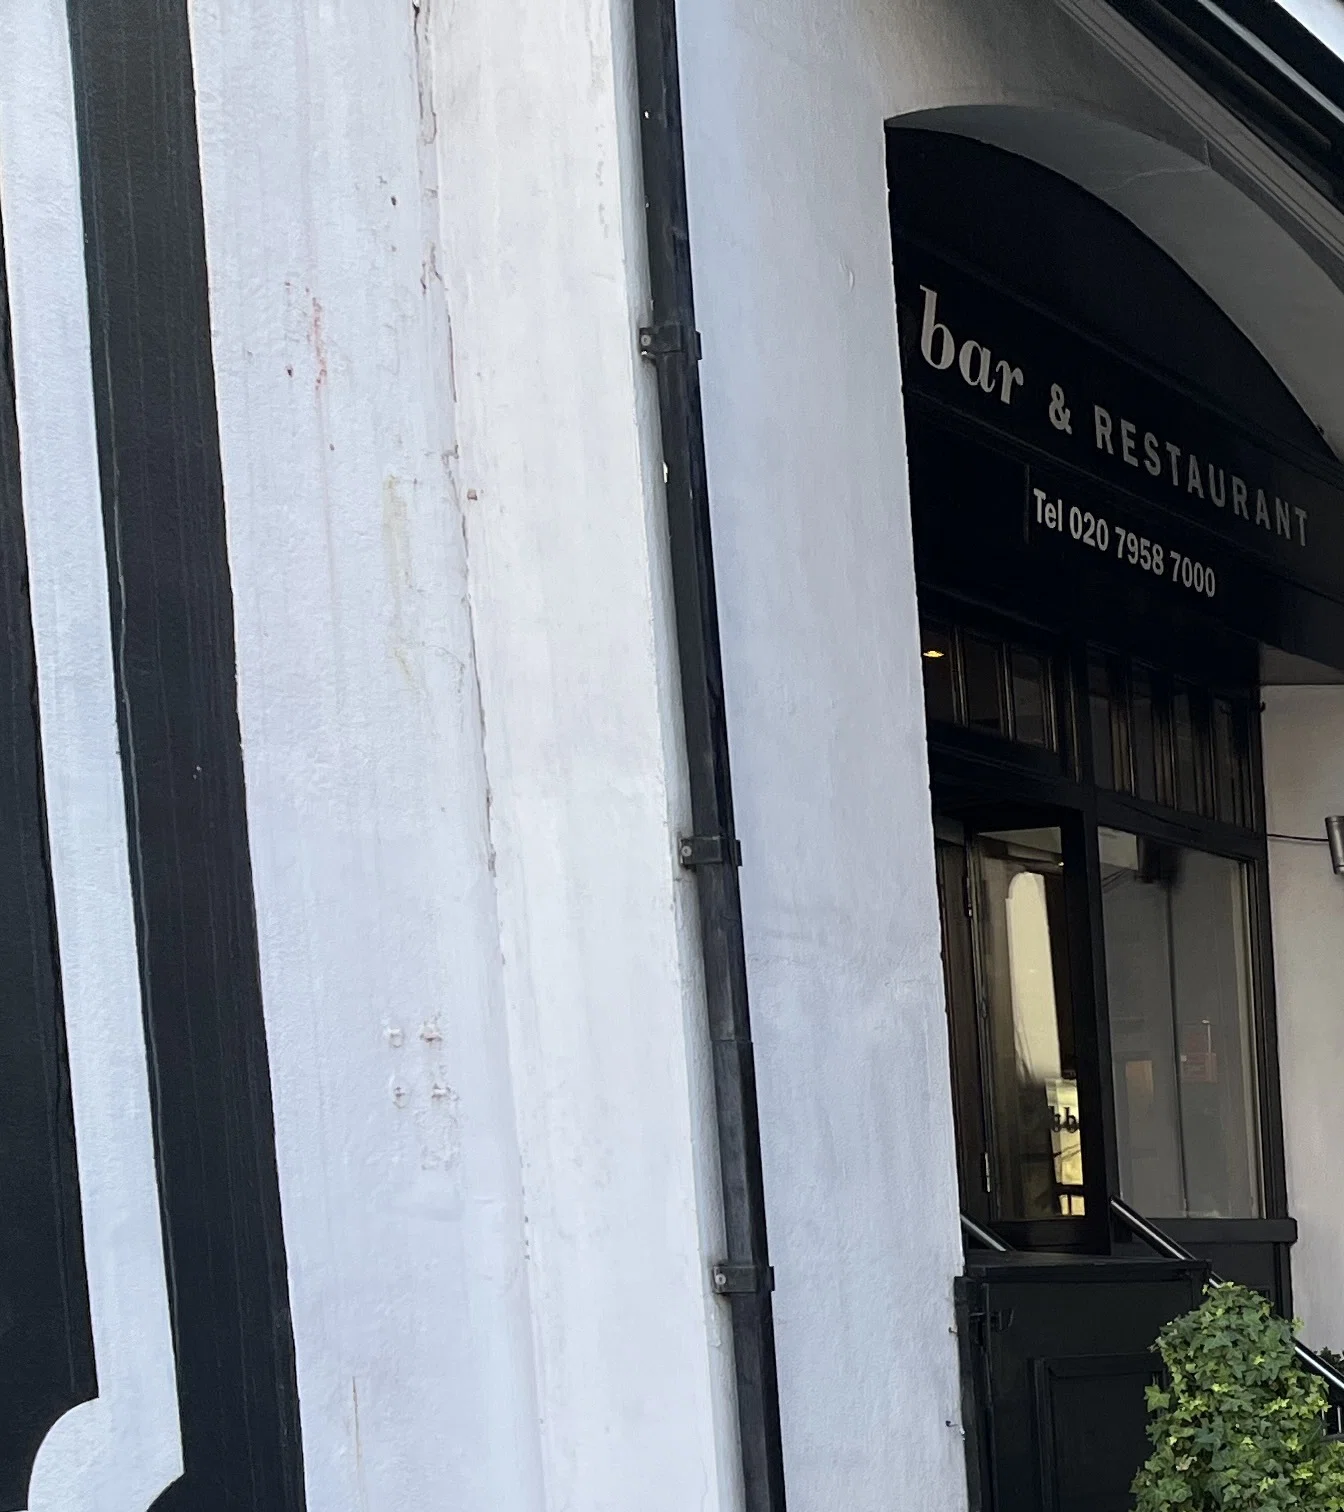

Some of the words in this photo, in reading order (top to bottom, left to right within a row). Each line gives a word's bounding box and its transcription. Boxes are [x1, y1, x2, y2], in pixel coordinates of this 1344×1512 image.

[919, 284, 1024, 405] bar
[1048, 383, 1073, 435] &
[1093, 404, 1309, 547] RESTAURANT
[1033, 488, 1063, 532] Tel
[1069, 506, 1109, 552] 020
[1115, 526, 1164, 576] 7958
[1170, 550, 1216, 598] 7000
